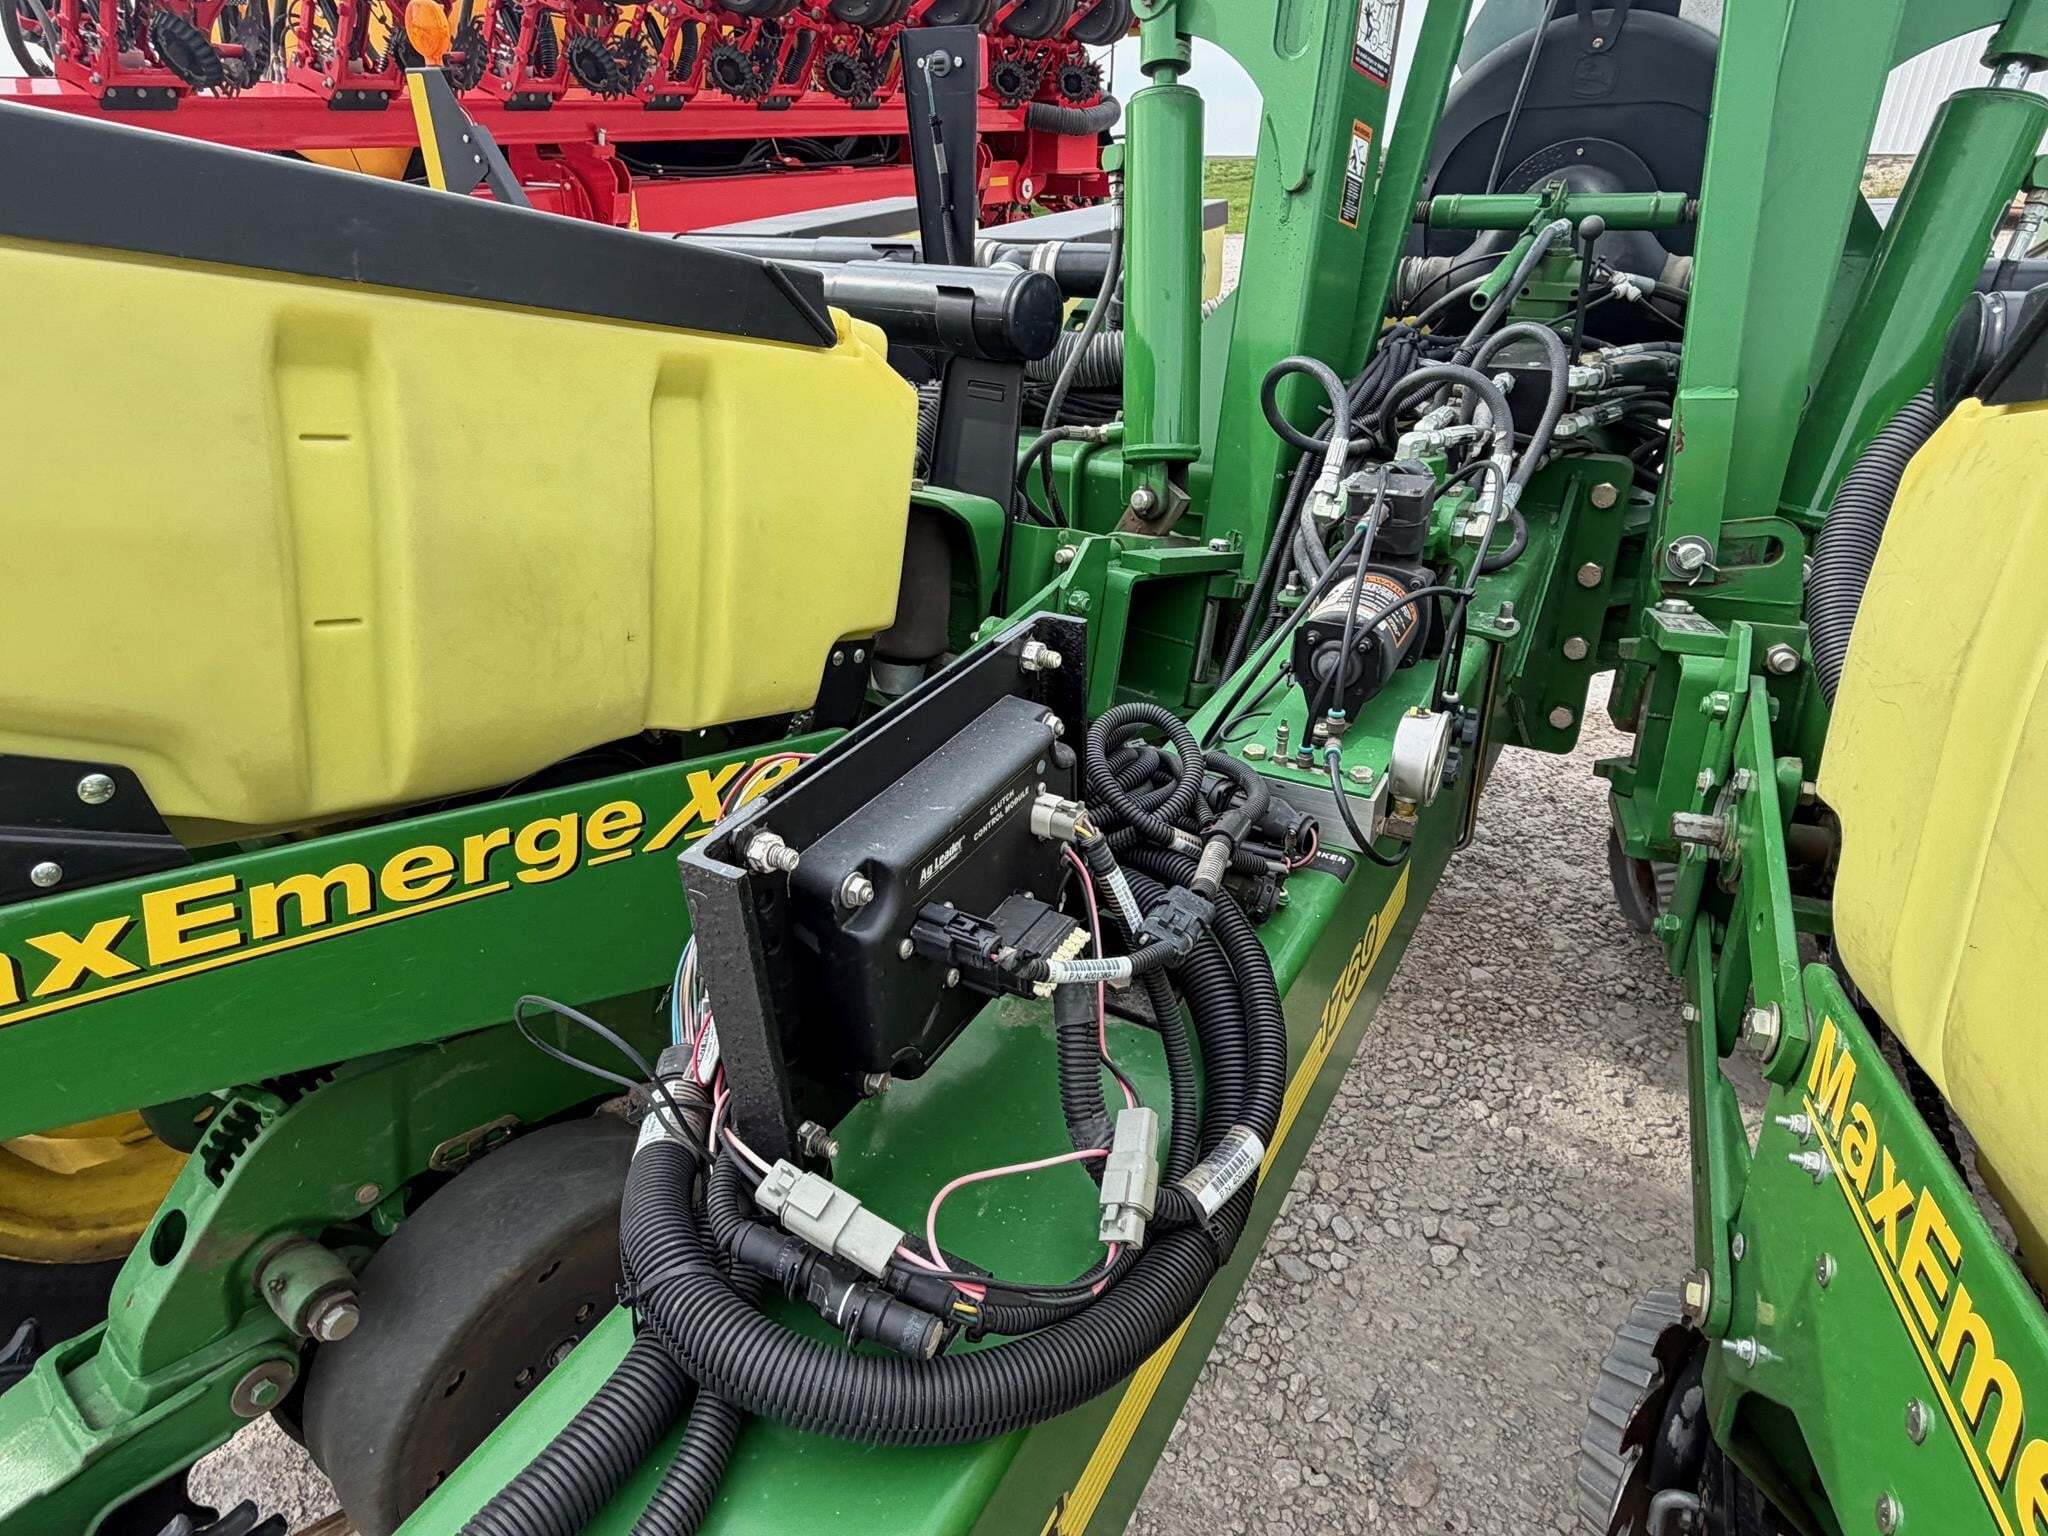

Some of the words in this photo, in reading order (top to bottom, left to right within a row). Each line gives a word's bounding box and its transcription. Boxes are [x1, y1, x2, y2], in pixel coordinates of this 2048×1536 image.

[973, 811, 1004, 841] CONTROL
[1005, 786, 1030, 814] MODULE
[989, 789, 1015, 815] CLUTCH
[919, 864, 933, 885] Ag
[934, 838, 963, 871] Leader
[0, 799, 645, 1007] xEmerge
[1320, 911, 1379, 1054] 1760
